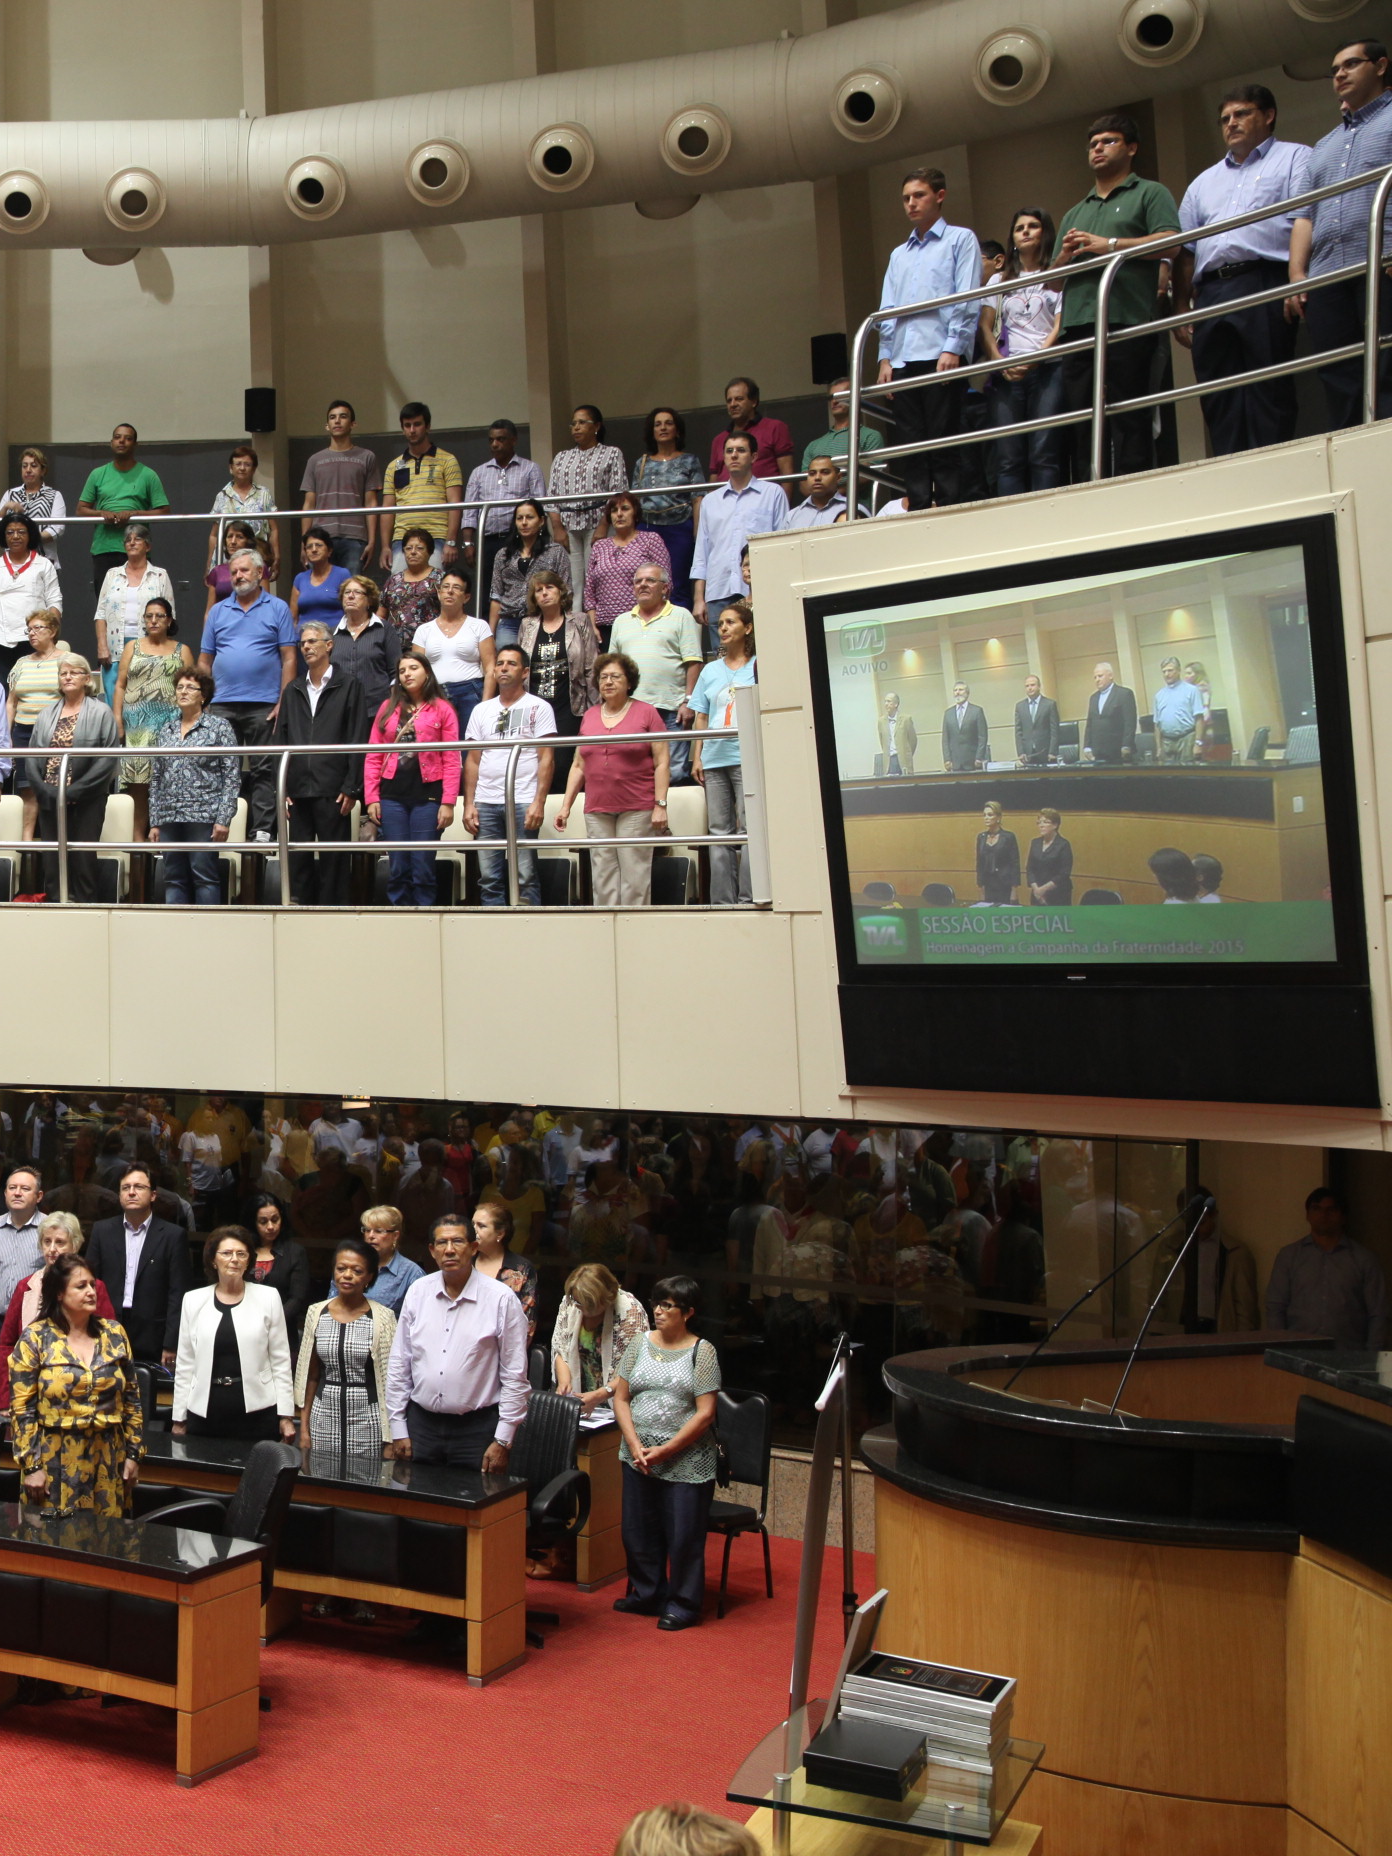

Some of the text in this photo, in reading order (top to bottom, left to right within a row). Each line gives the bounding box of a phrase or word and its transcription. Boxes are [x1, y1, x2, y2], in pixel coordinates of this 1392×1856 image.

[842, 661, 888, 676] AO VIVO
[922, 913, 1075, 934] SESSÃO ESPECIAL
[925, 941, 1005, 956] Homenagem
[1019, 940, 1088, 956] Campanha
[1093, 940, 1109, 954] da
[1112, 939, 1204, 955] Fraternidade
[1208, 939, 1245, 955] 2015
